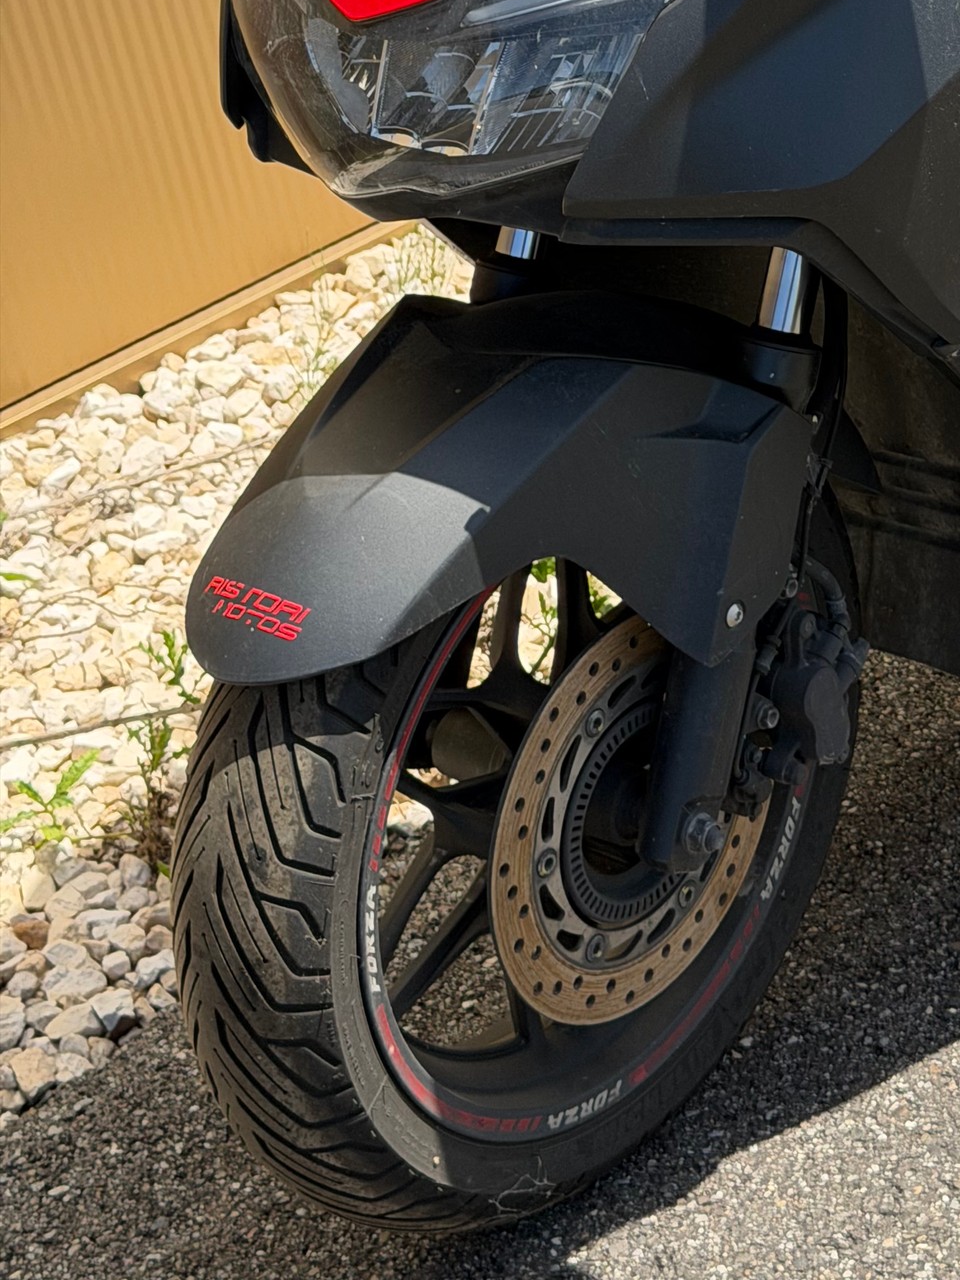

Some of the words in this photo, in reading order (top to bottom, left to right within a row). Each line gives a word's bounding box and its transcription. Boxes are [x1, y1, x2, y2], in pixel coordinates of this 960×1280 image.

[760, 796, 801, 901] FORZA
[364, 884, 382, 993] FORZA
[547, 1079, 622, 1130] FORZA
